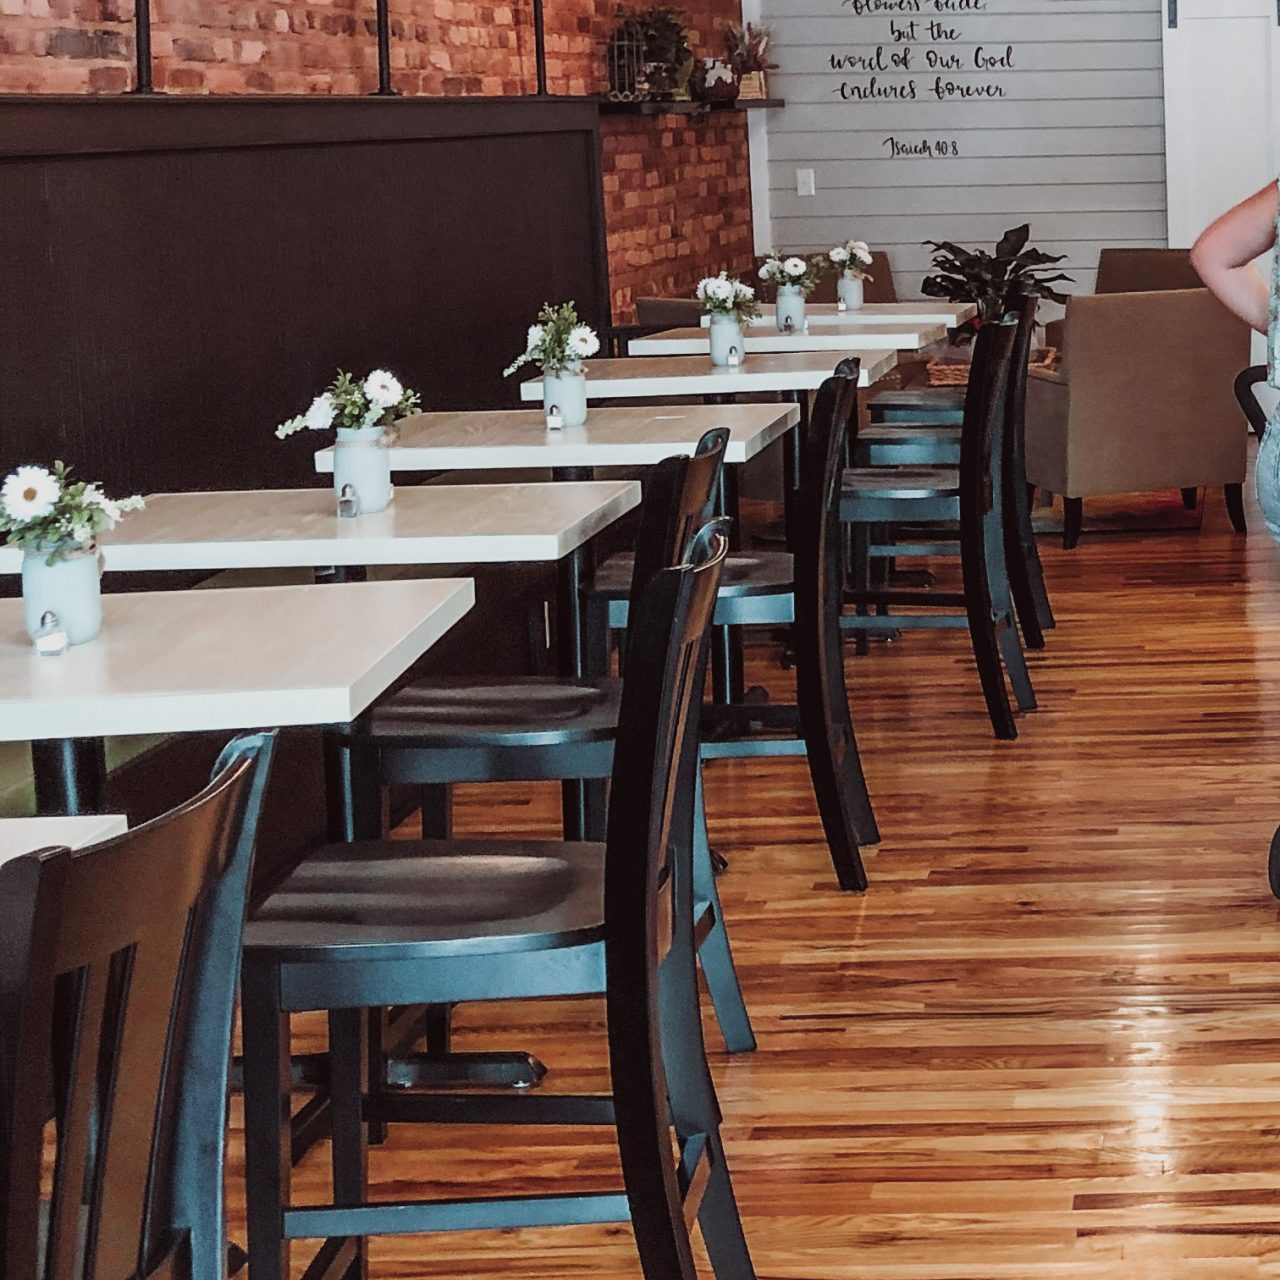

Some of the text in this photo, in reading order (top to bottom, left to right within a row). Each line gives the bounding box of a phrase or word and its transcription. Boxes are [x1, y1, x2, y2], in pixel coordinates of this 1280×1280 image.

[890, 20, 963, 42] but the
[829, 46, 888, 71] word
[891, 47, 912, 70] of
[974, 46, 1015, 71] God
[882, 137, 932, 159] Isaiah
